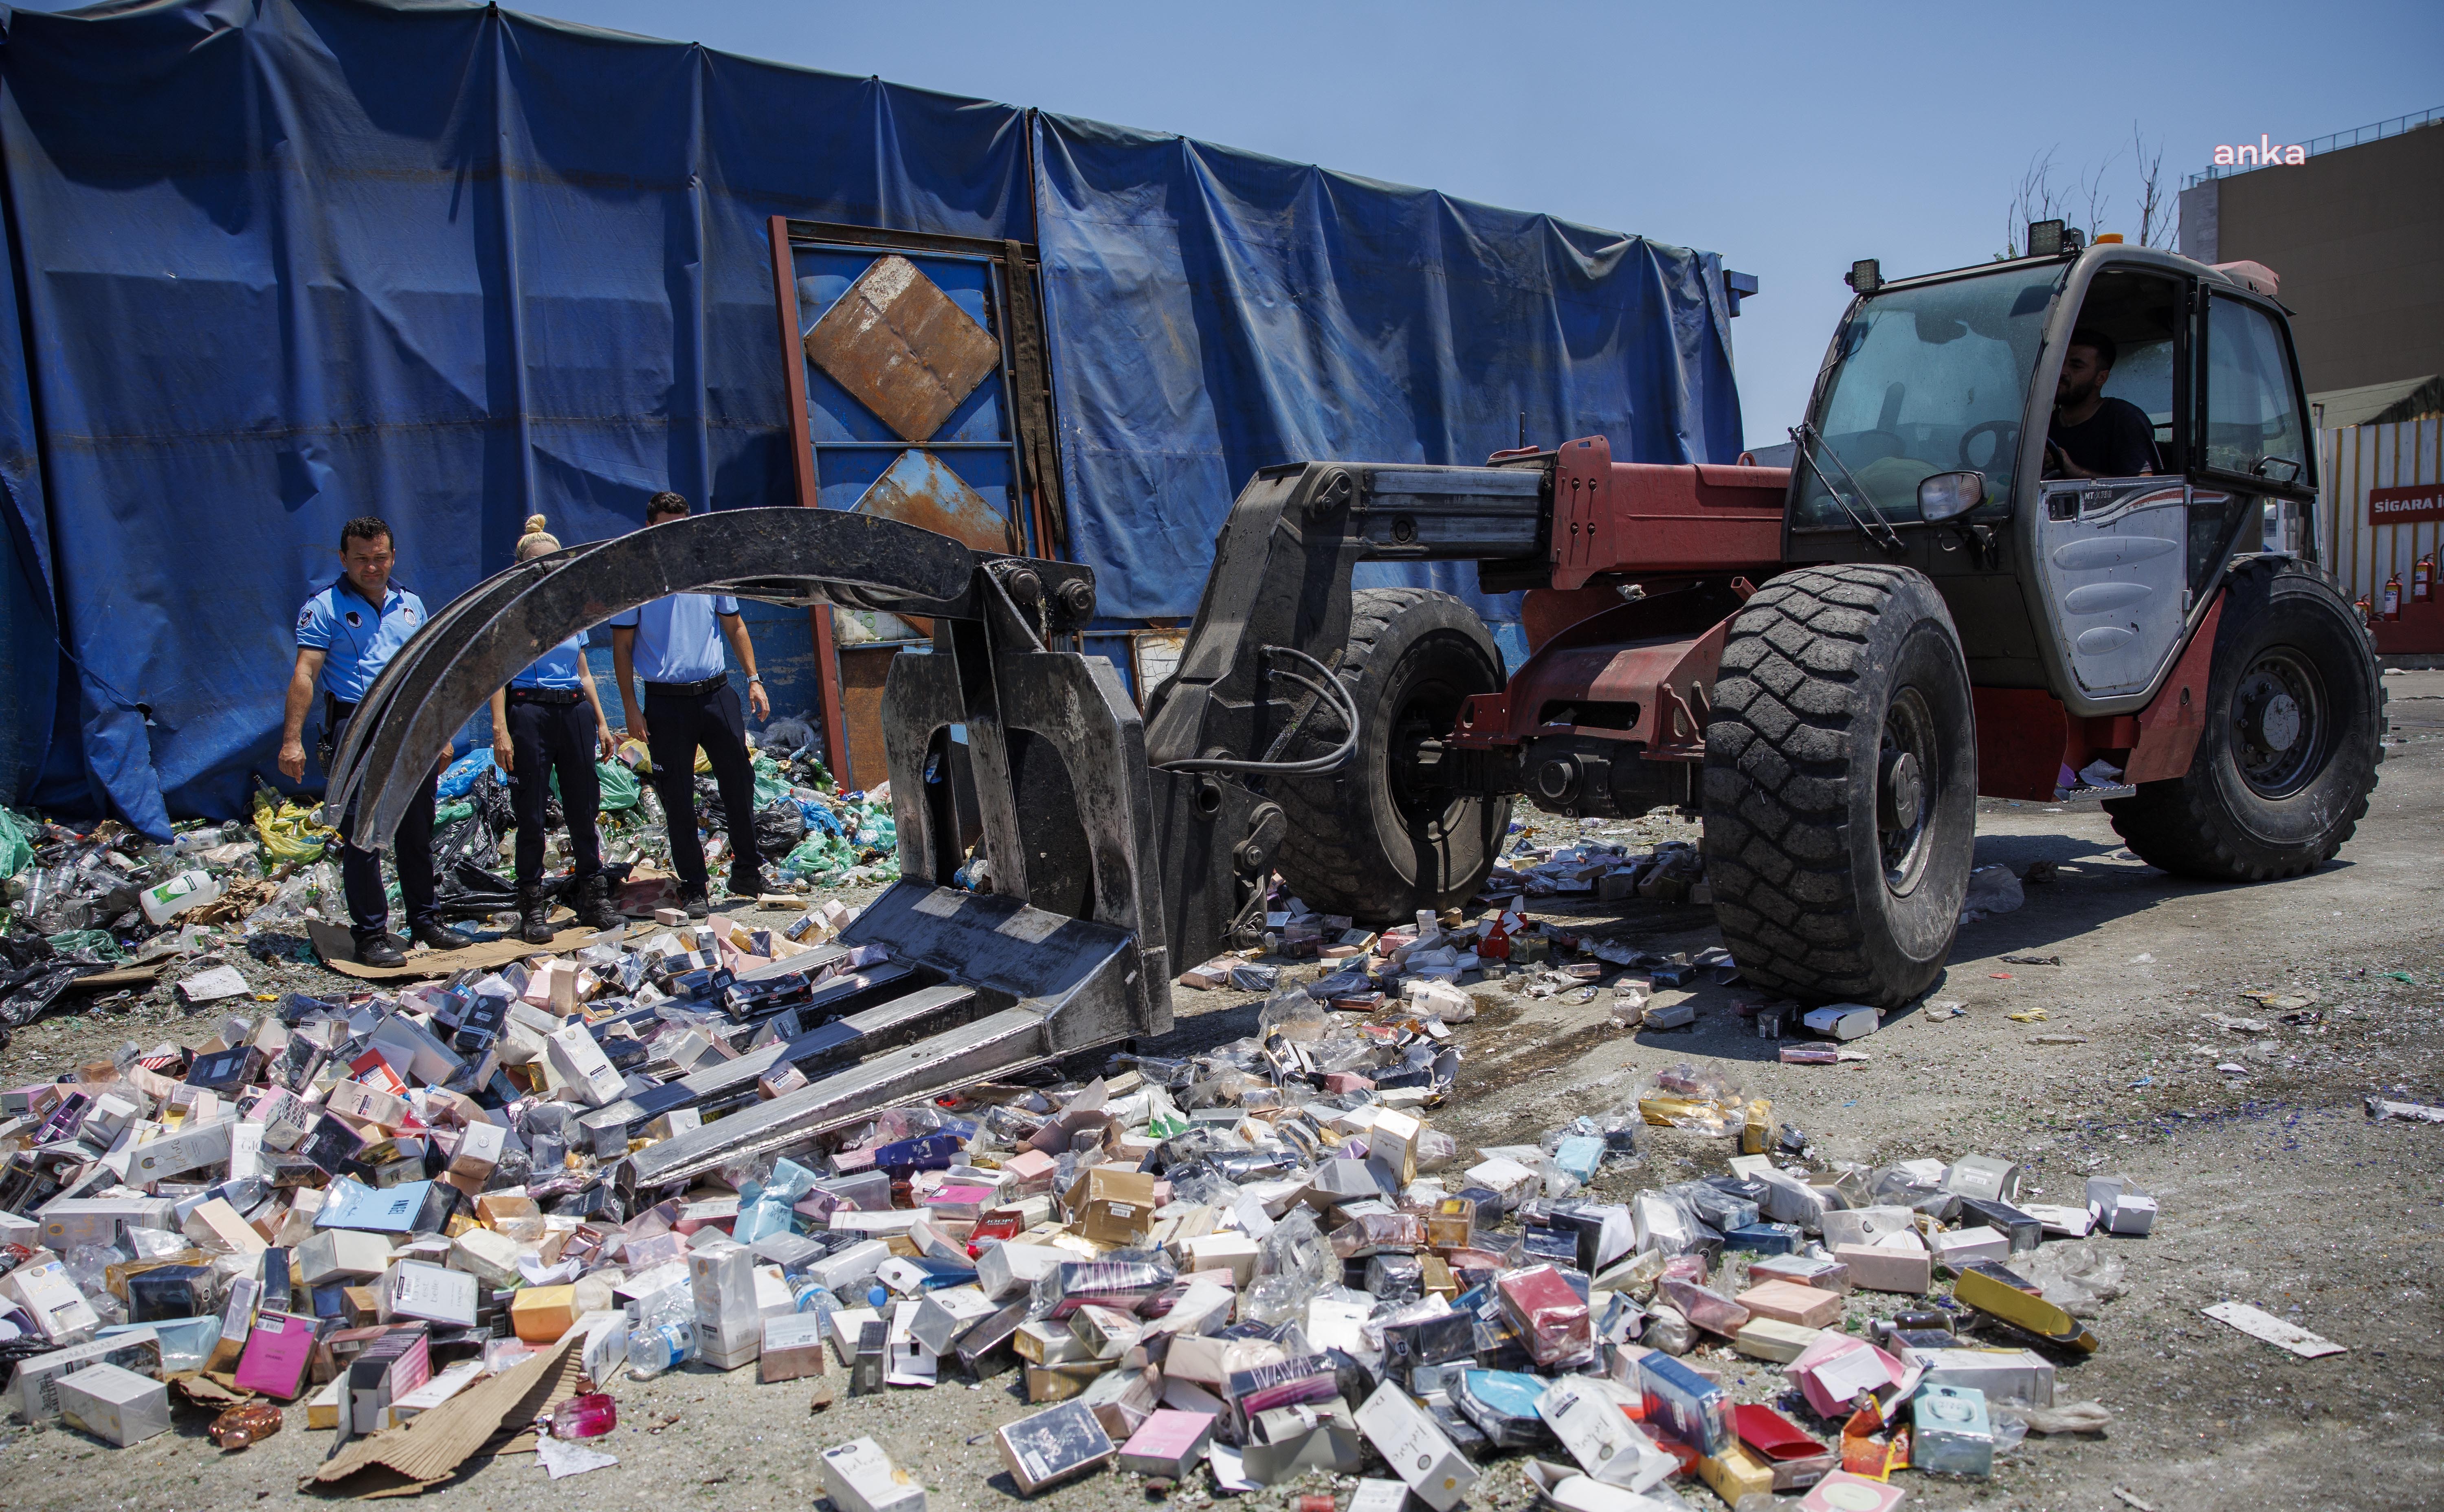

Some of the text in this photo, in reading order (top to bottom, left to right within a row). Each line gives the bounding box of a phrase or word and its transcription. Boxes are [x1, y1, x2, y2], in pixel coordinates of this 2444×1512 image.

[2375, 494, 2444, 512] SİGARA İ
[652, 761, 663, 771] ABITA
[242, 1140, 265, 1150] GIO
[388, 1200, 409, 1215] ANGEL
